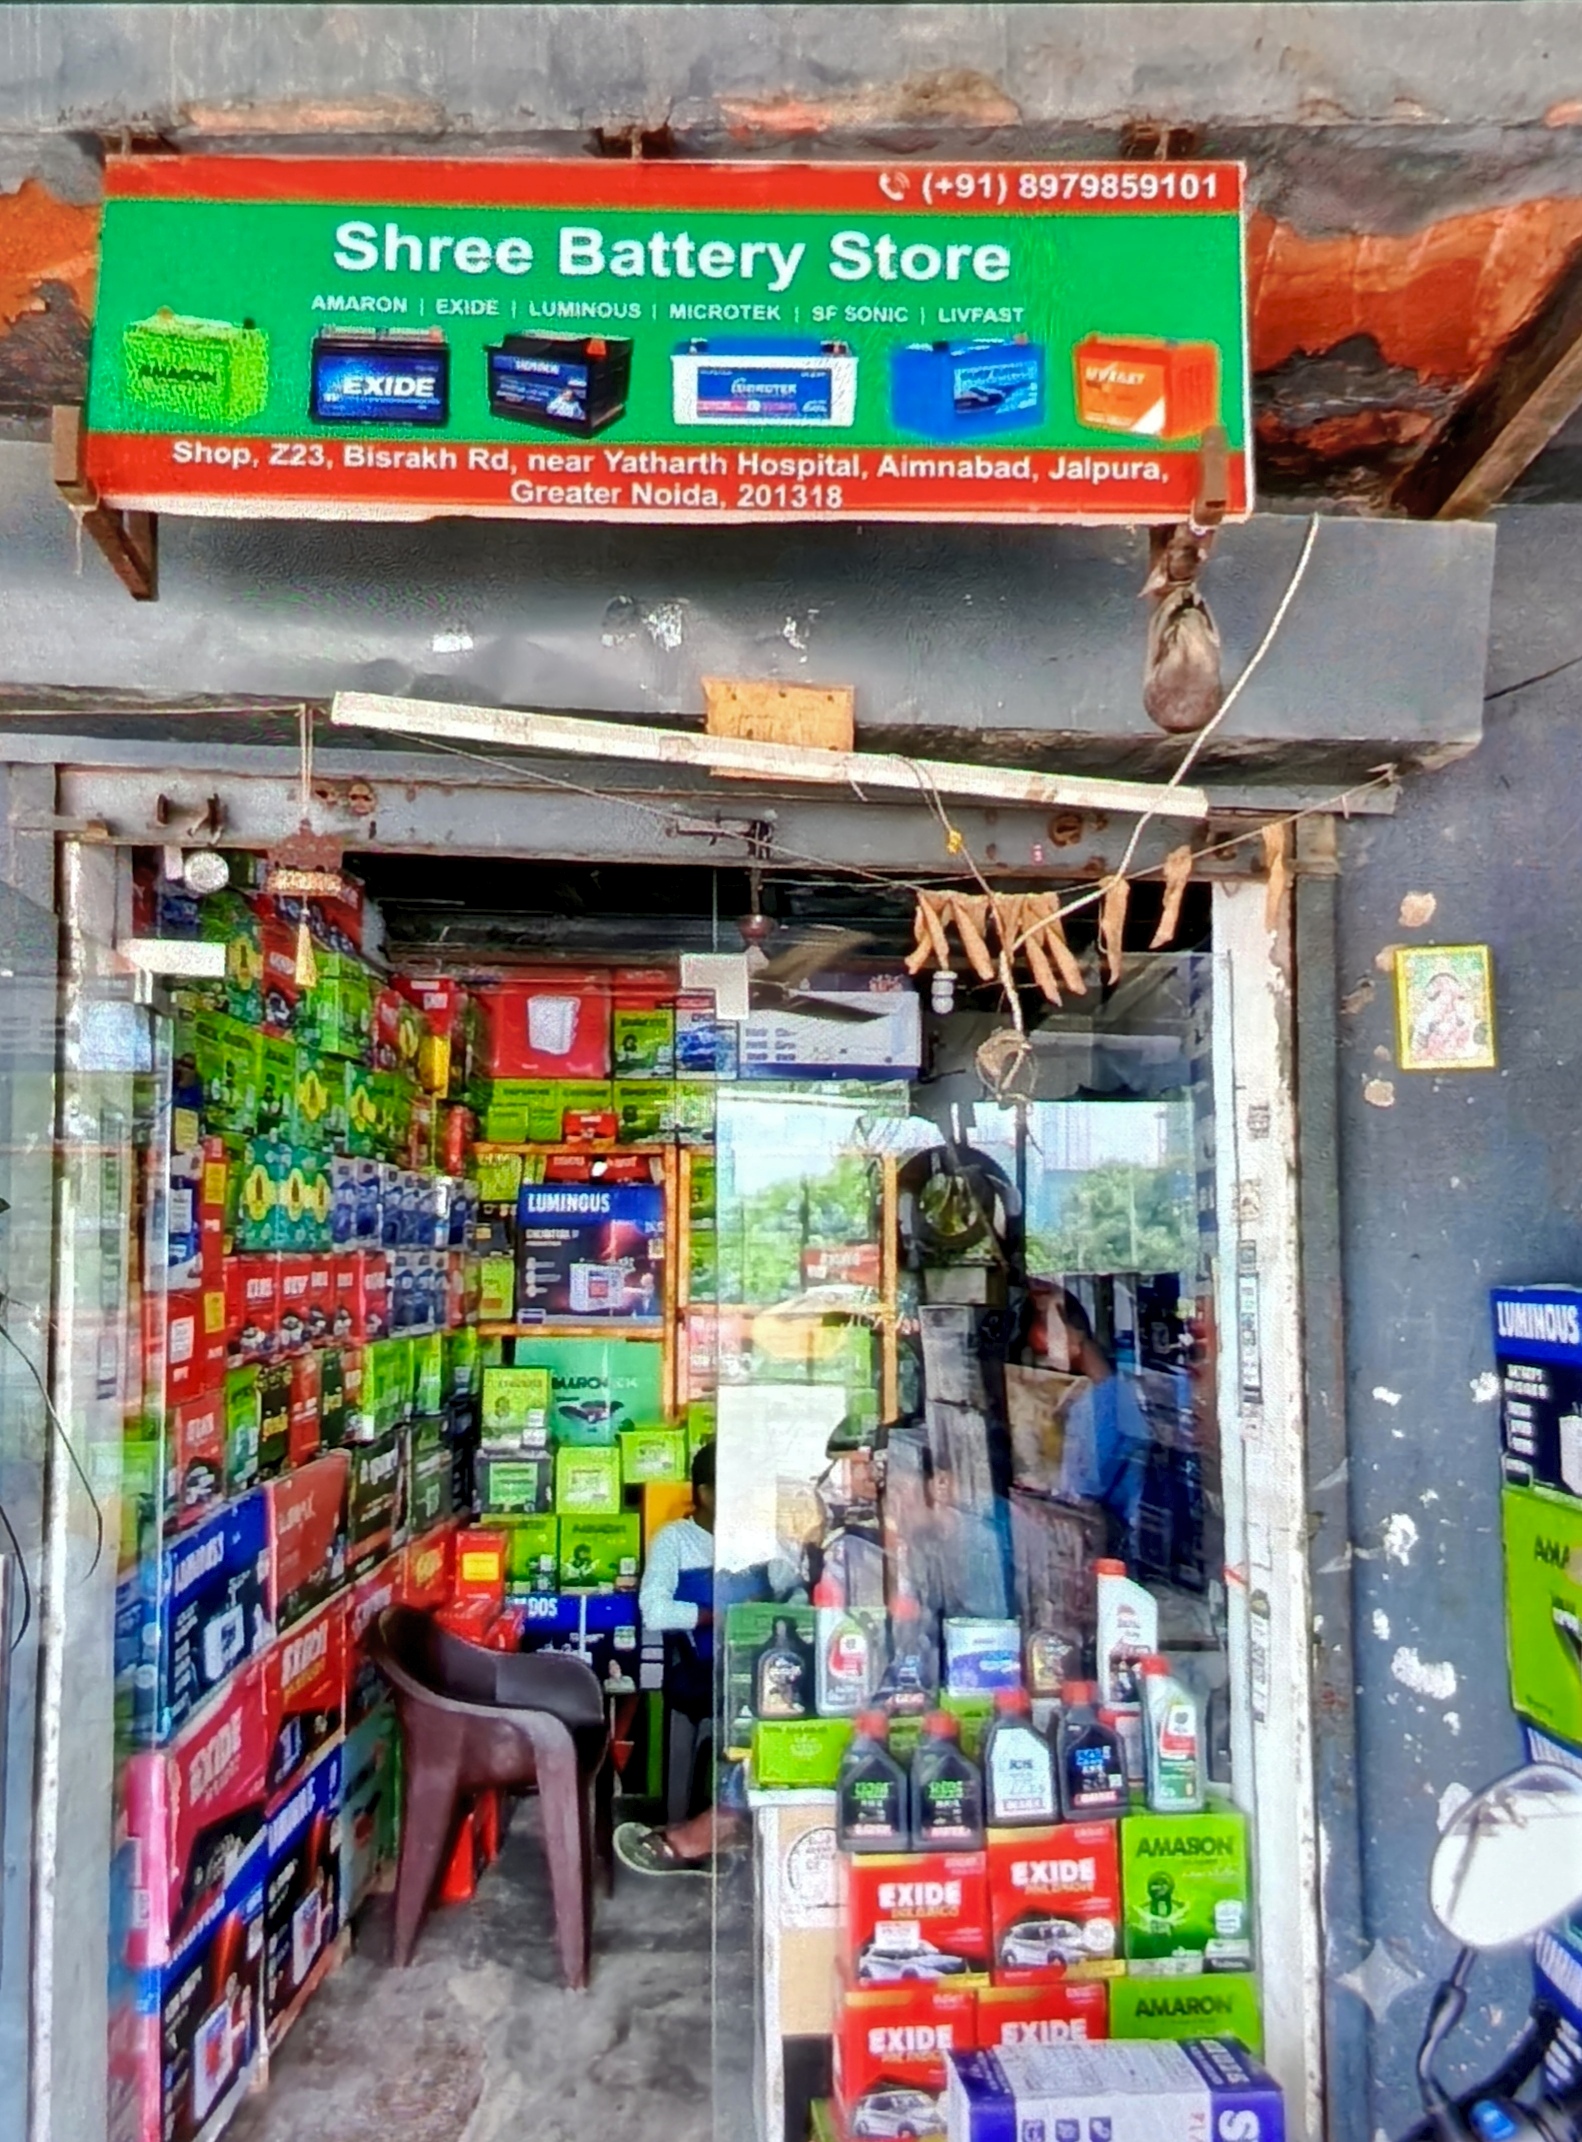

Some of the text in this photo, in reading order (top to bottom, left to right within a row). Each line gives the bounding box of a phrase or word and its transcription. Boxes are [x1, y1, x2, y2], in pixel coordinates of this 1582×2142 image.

[922, 172, 1217, 203] (+91) 8979859101
[334, 223, 1011, 291] Shree Battery Store
[311, 295, 408, 313] AMARON
[435, 298, 499, 316] EXIDE
[529, 301, 642, 319] LUMINOUS
[669, 303, 781, 321] MICROTEK
[811, 306, 908, 322] SF SONIC
[938, 306, 1024, 323] LIVFAST
[341, 373, 437, 398] EXIDE
[172, 441, 1169, 484] Shop, Z23, Bisrakh Rd, near Yatharth Hospital, Aimnabad, Jalpura,
[510, 478, 844, 509] Greater Noida, 201318
[527, 1192, 611, 1214] LUMINOUS
[1497, 1301, 1580, 1345] LUMINOUS
[1010, 1856, 1096, 1889] EXIDE
[877, 1879, 962, 1910] EXIDE
[1134, 1994, 1234, 2018] AMARON
[867, 2023, 955, 2055] EXIDE
[999, 2017, 1088, 2044] EXIDE
